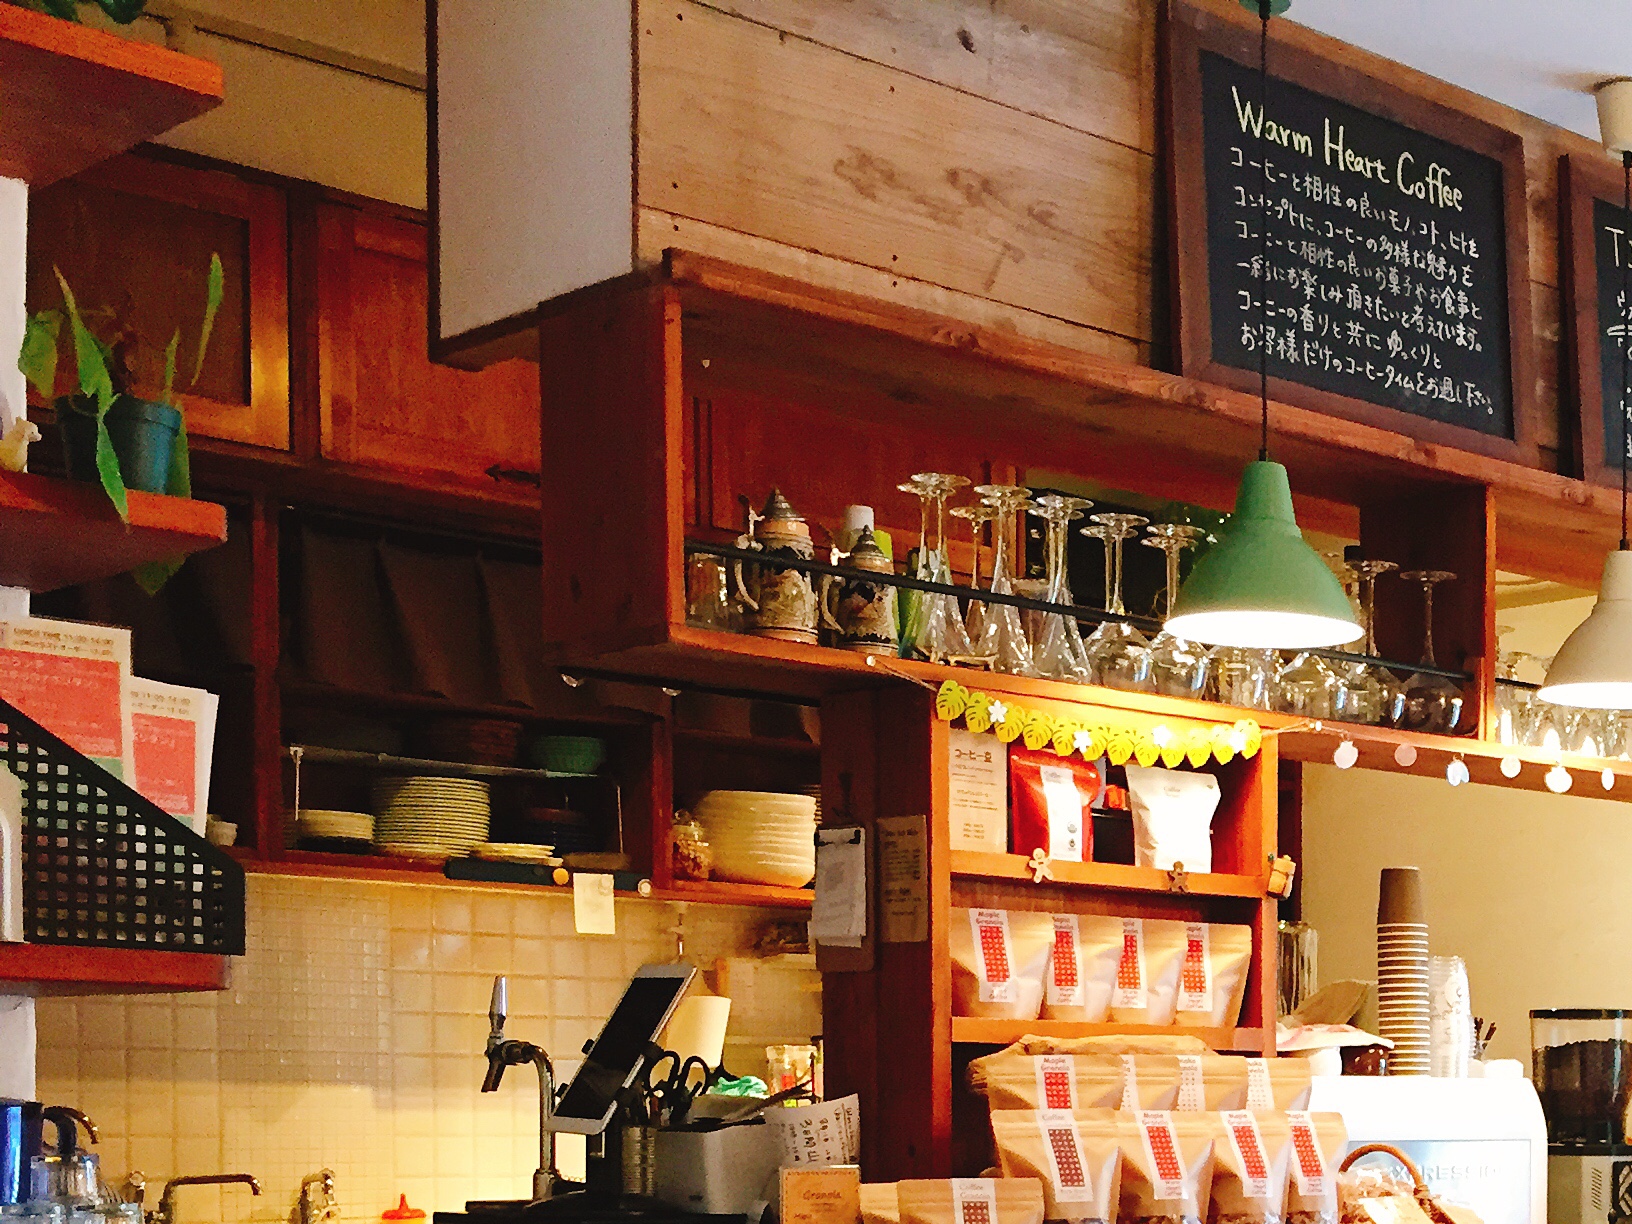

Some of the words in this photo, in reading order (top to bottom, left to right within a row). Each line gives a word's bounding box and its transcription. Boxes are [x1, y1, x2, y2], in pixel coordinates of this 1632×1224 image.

[1231, 86, 1313, 158] Warm
[1324, 117, 1390, 184] Heart
[1397, 151, 1464, 212] Coffee
